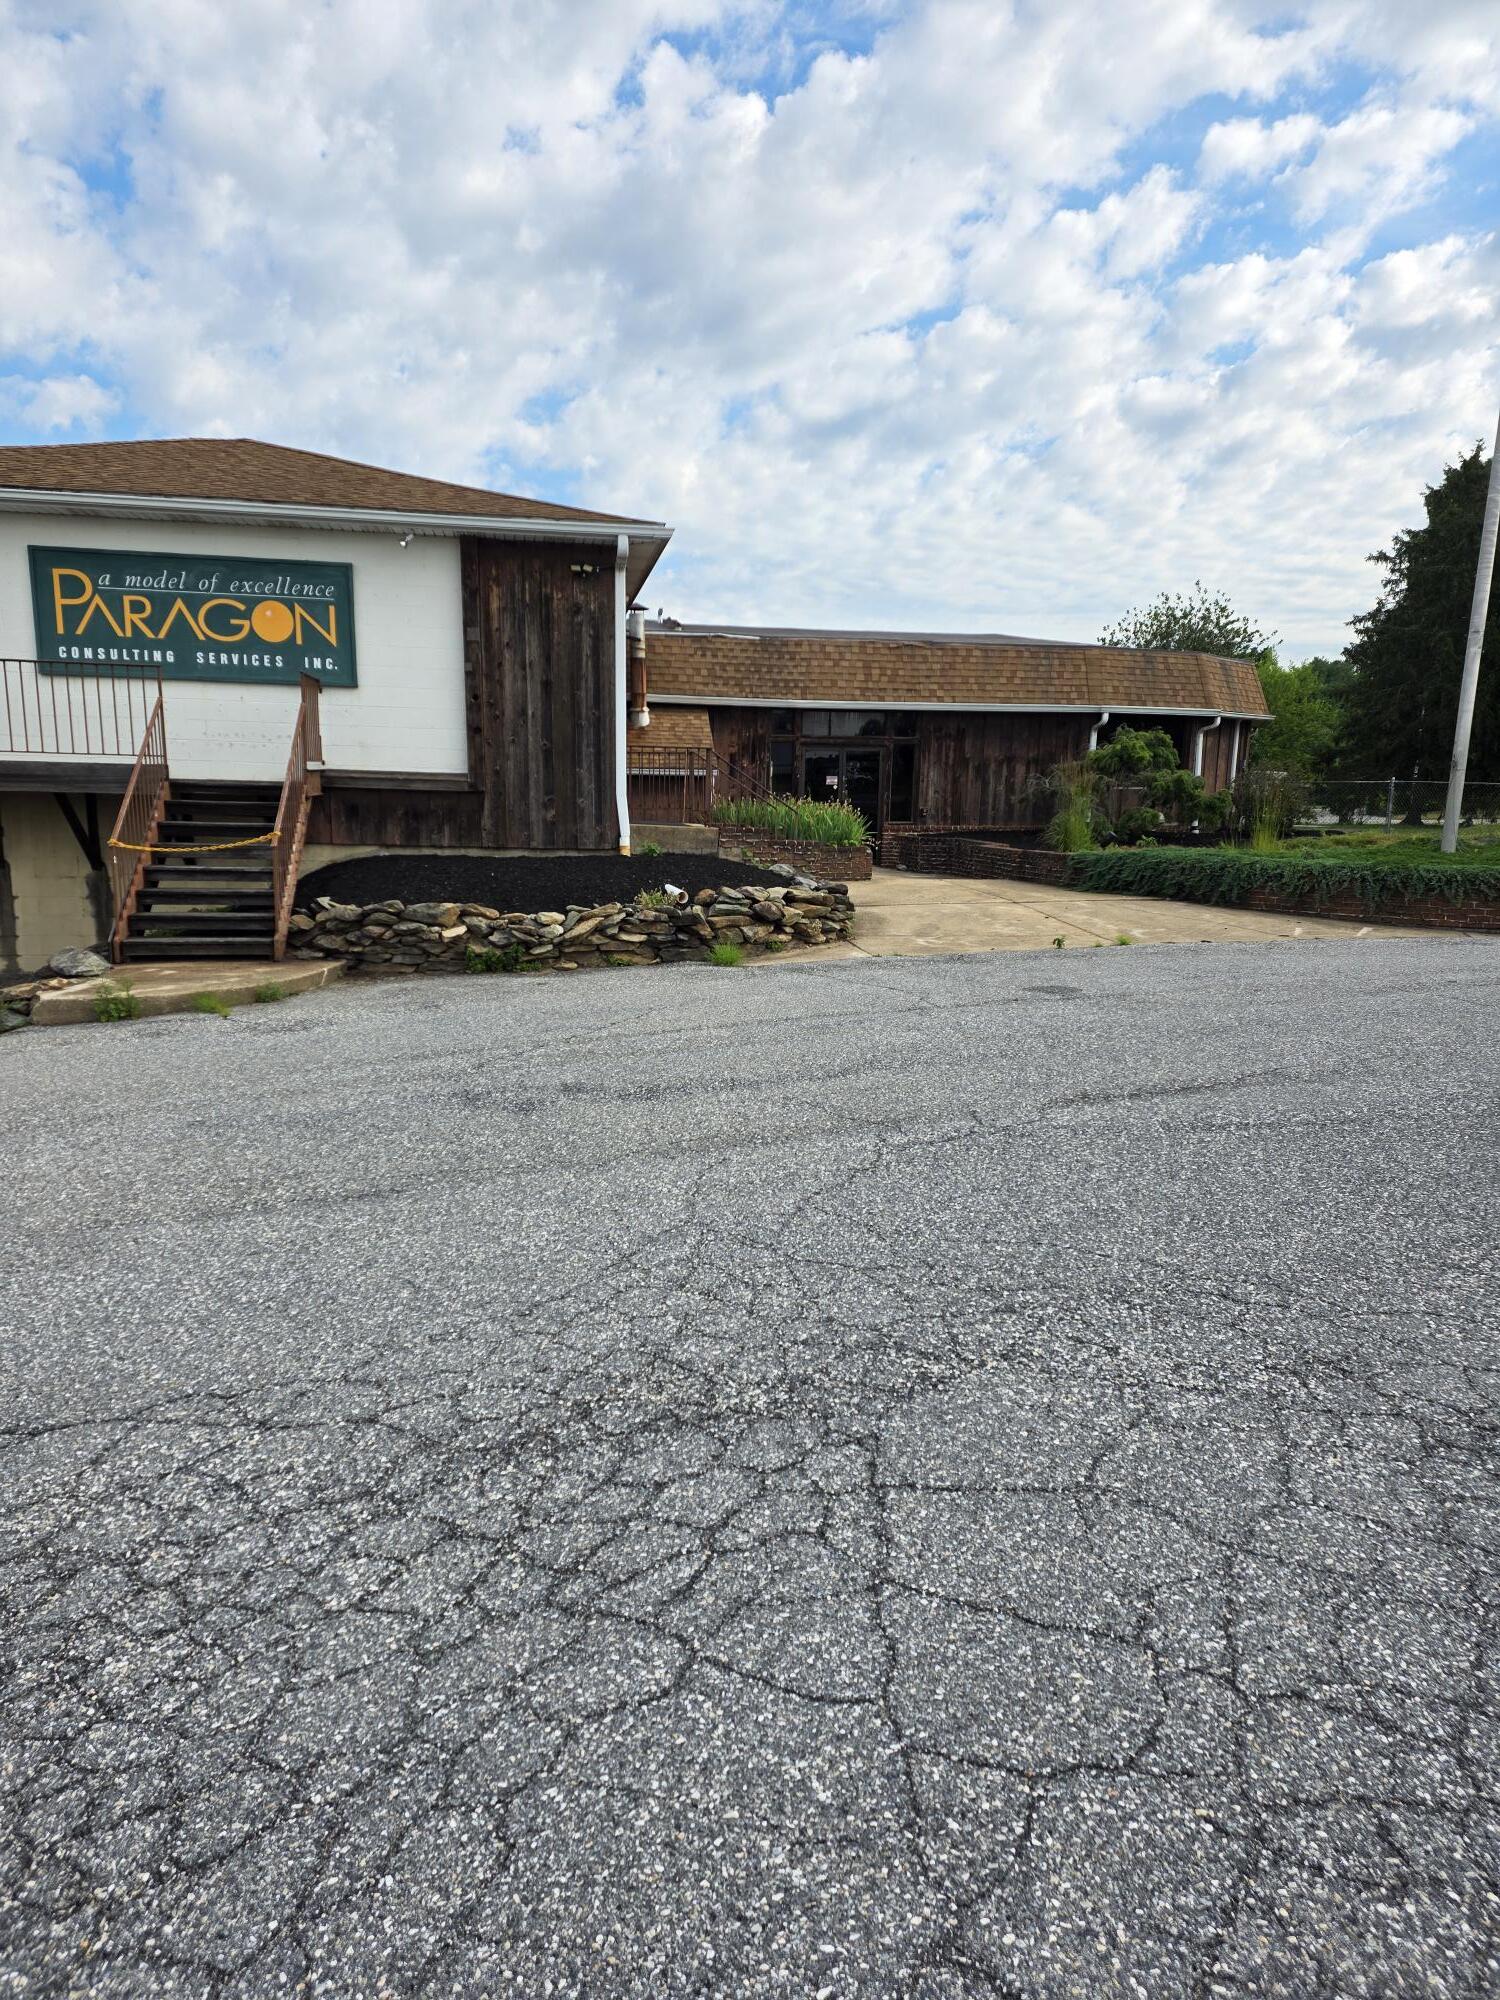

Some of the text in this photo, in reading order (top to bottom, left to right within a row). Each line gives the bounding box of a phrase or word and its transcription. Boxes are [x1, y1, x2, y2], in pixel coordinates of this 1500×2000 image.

[98, 570, 335, 597] a model of excellence
[52, 568, 337, 647] PARAGON
[58, 646, 339, 671] CONSULTING SERVICES INC.
